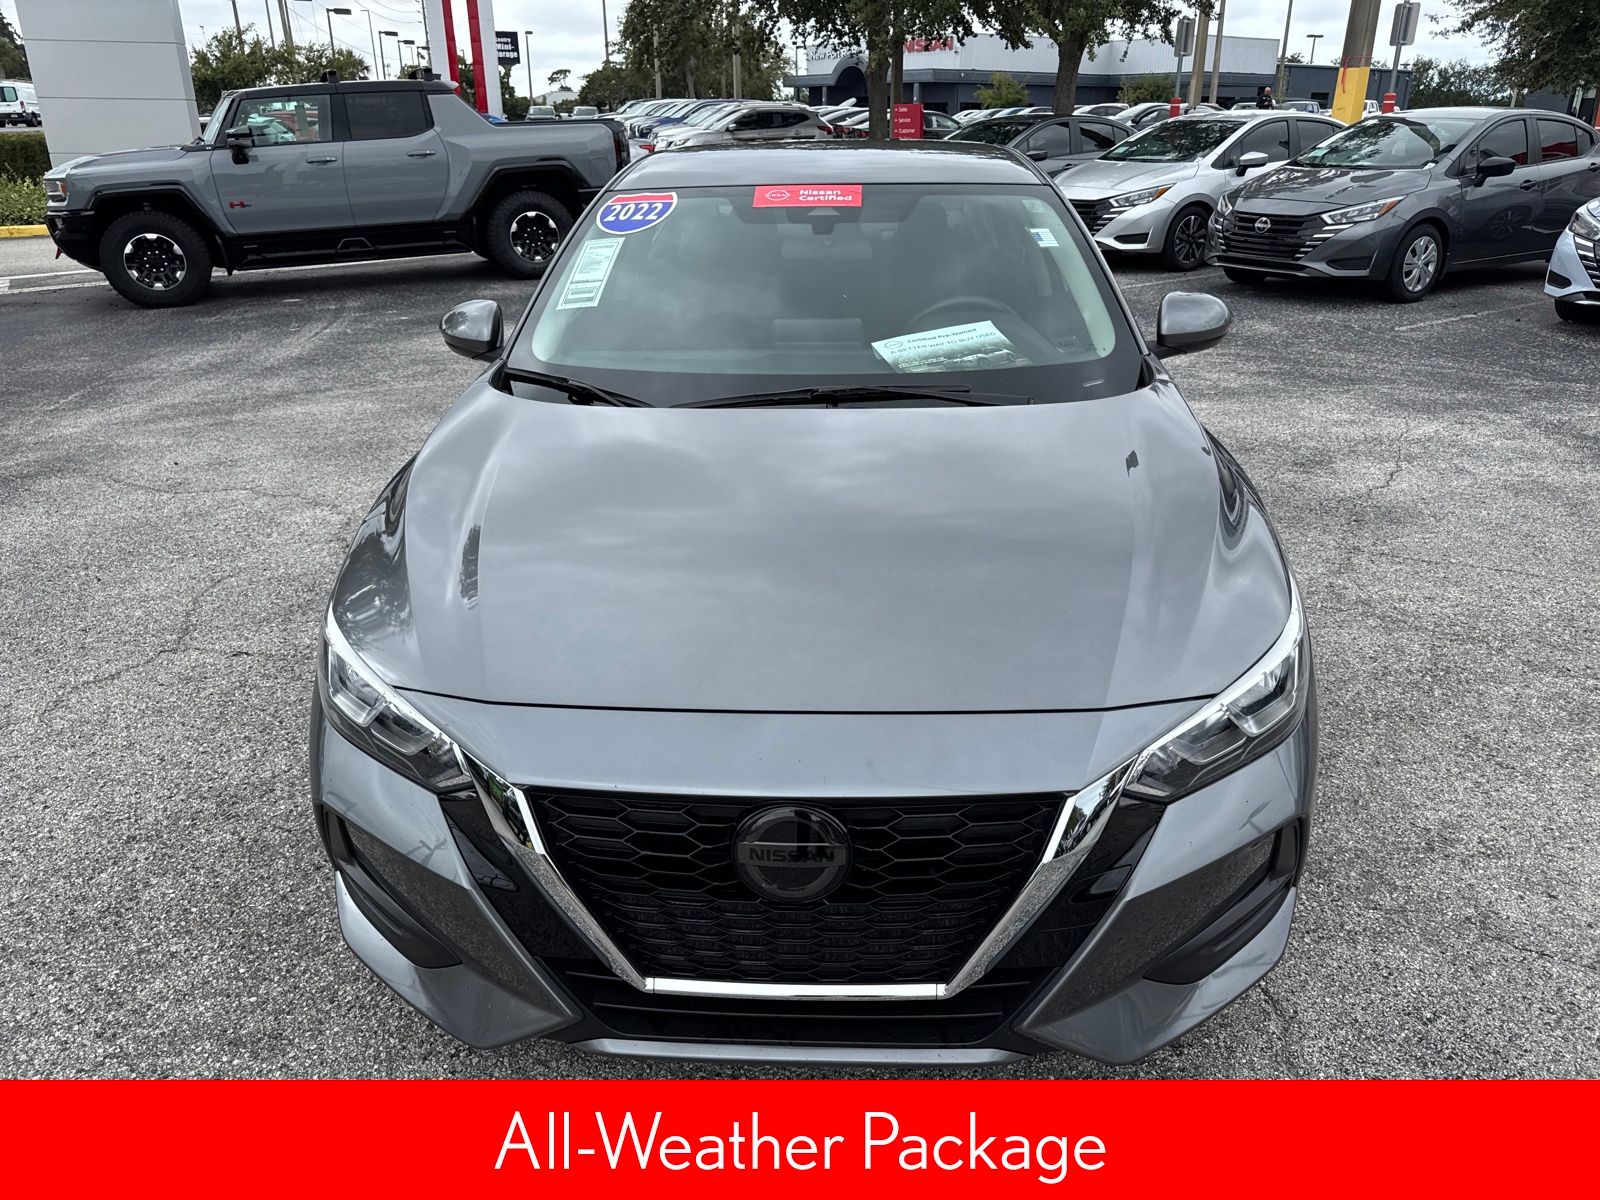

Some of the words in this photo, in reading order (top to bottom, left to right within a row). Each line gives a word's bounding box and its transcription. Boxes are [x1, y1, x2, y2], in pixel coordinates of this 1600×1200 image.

[902, 36, 954, 52] NISAN
[603, 203, 663, 221] 2022
[907, 335, 938, 343] Certified
[748, 848, 835, 863] NISSAN
